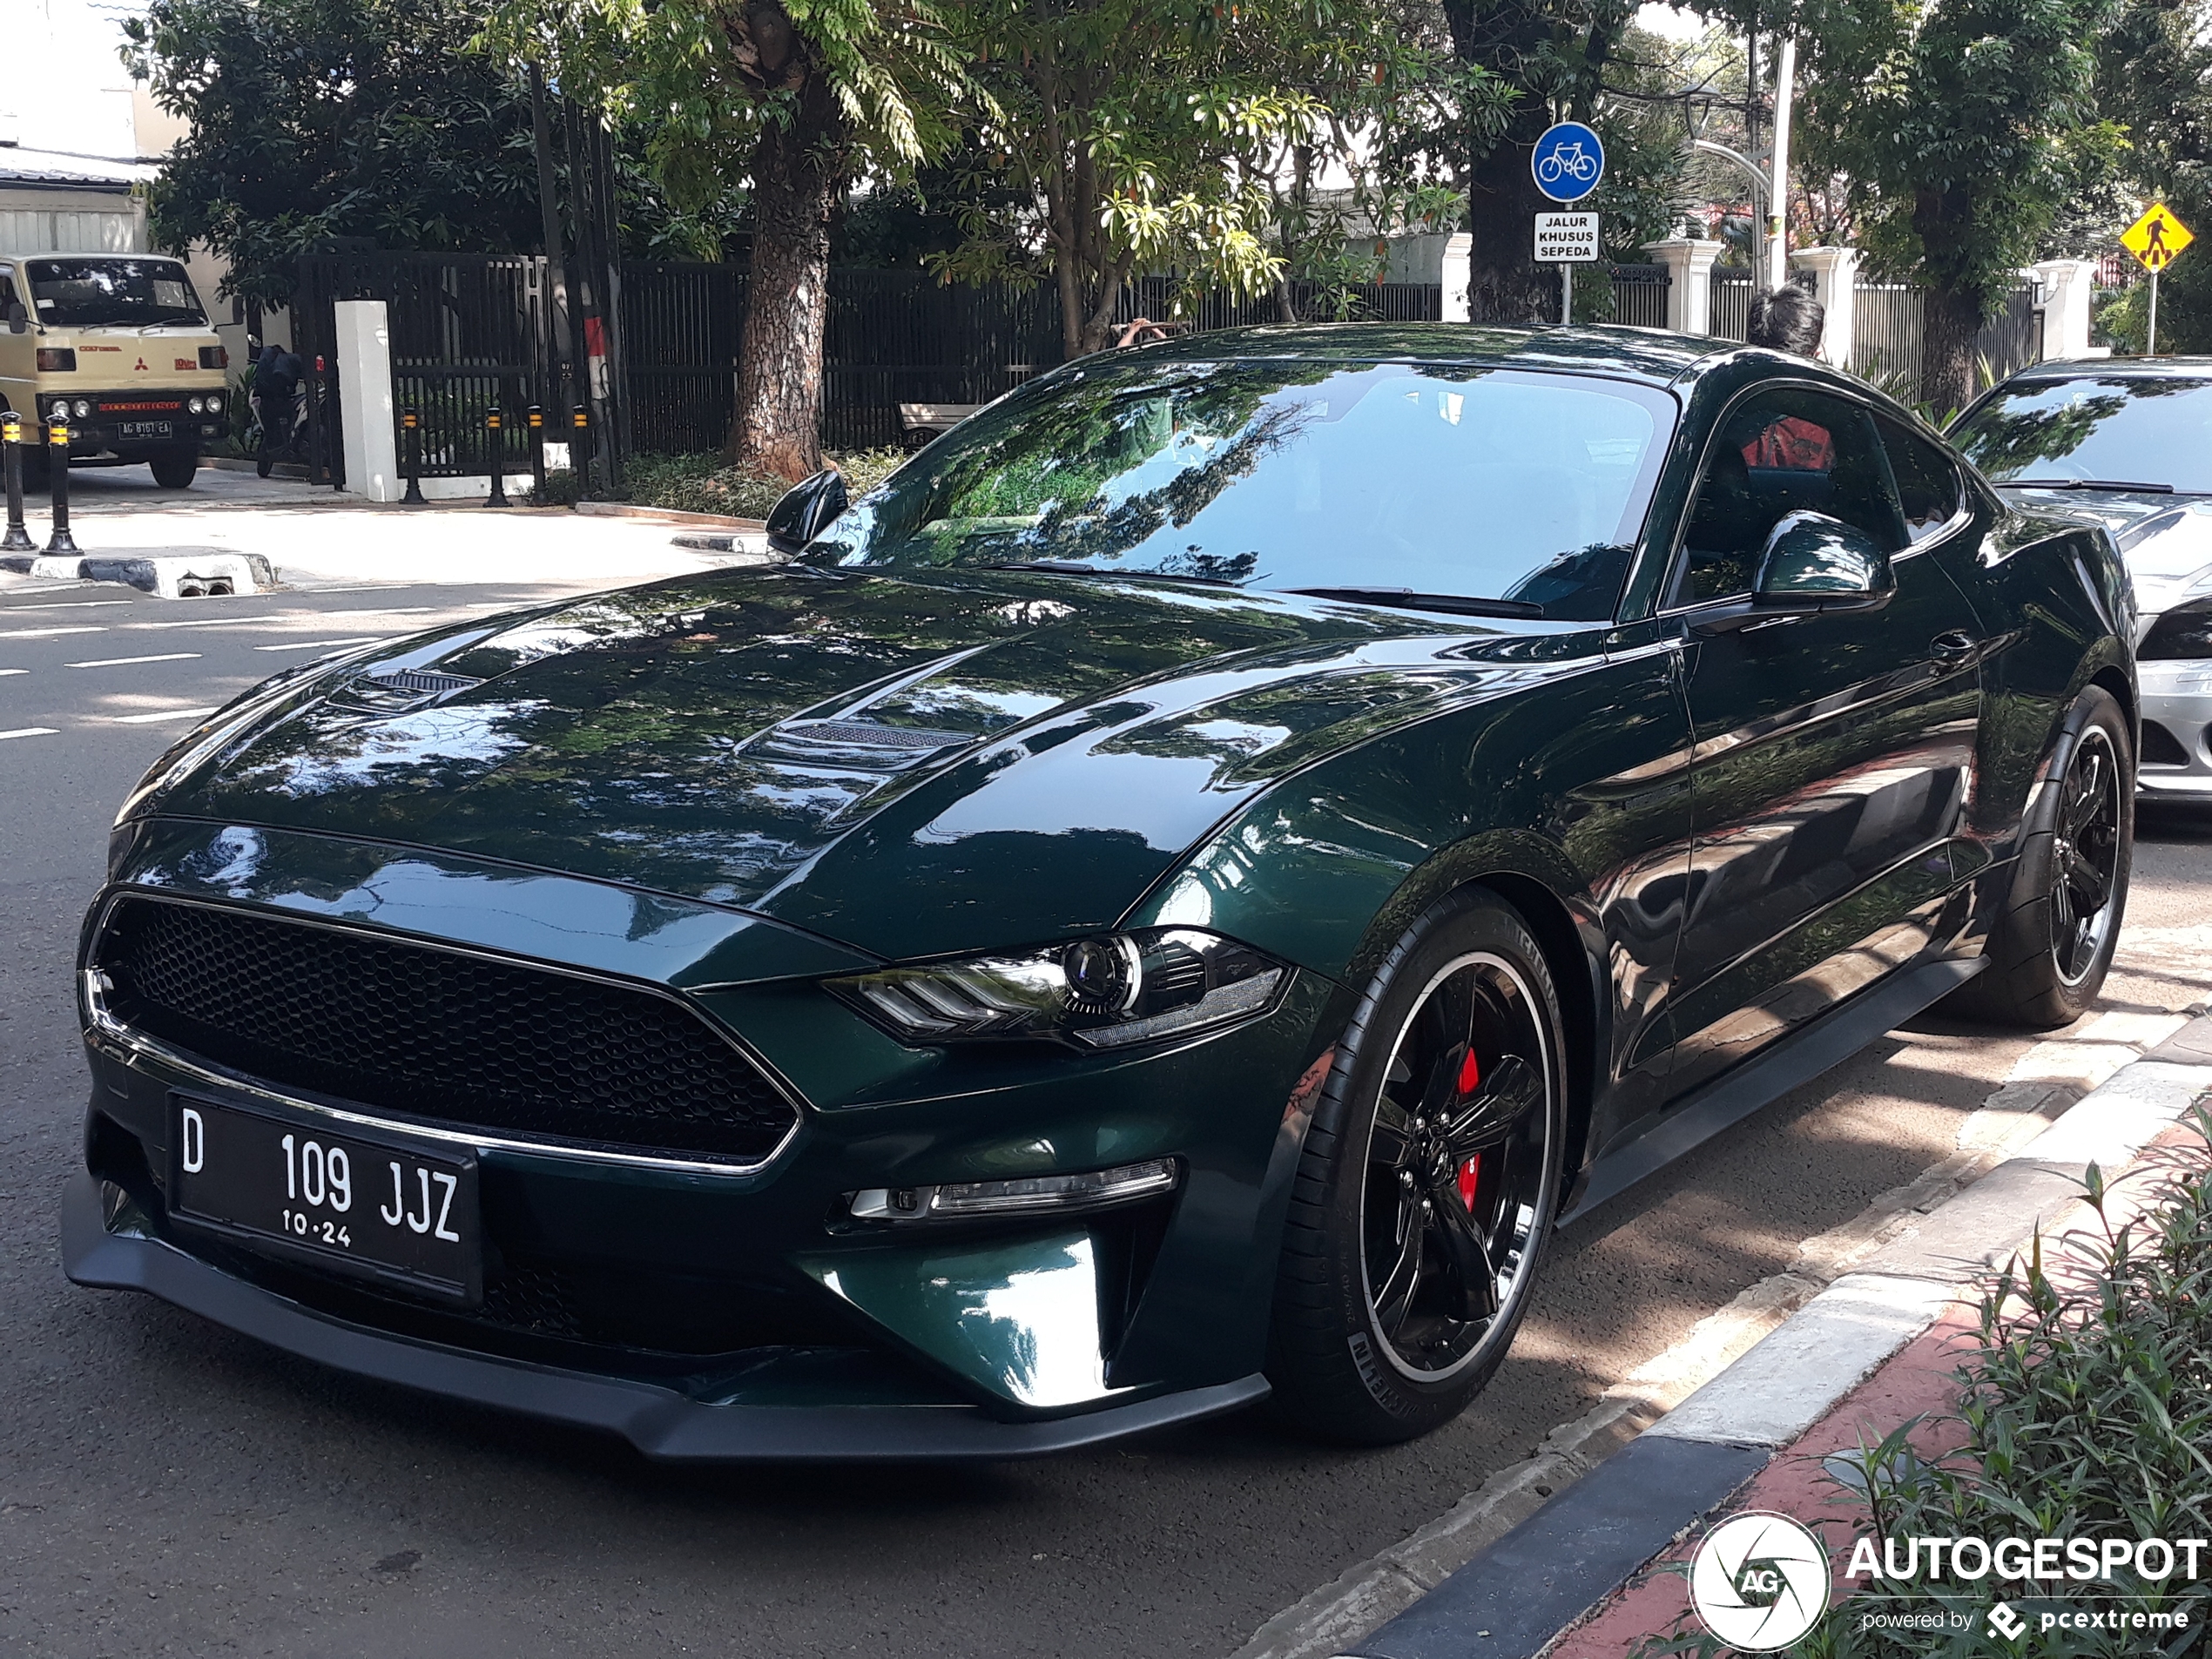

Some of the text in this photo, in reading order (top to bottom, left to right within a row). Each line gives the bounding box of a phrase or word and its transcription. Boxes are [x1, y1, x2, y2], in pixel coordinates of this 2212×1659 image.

[1546, 217, 1588, 227] JALUR
[1539, 232, 1594, 242] KHUSUS
[1541, 246, 1591, 257] SEPEDA
[183, 1108, 460, 1243] D 109 JJZ
